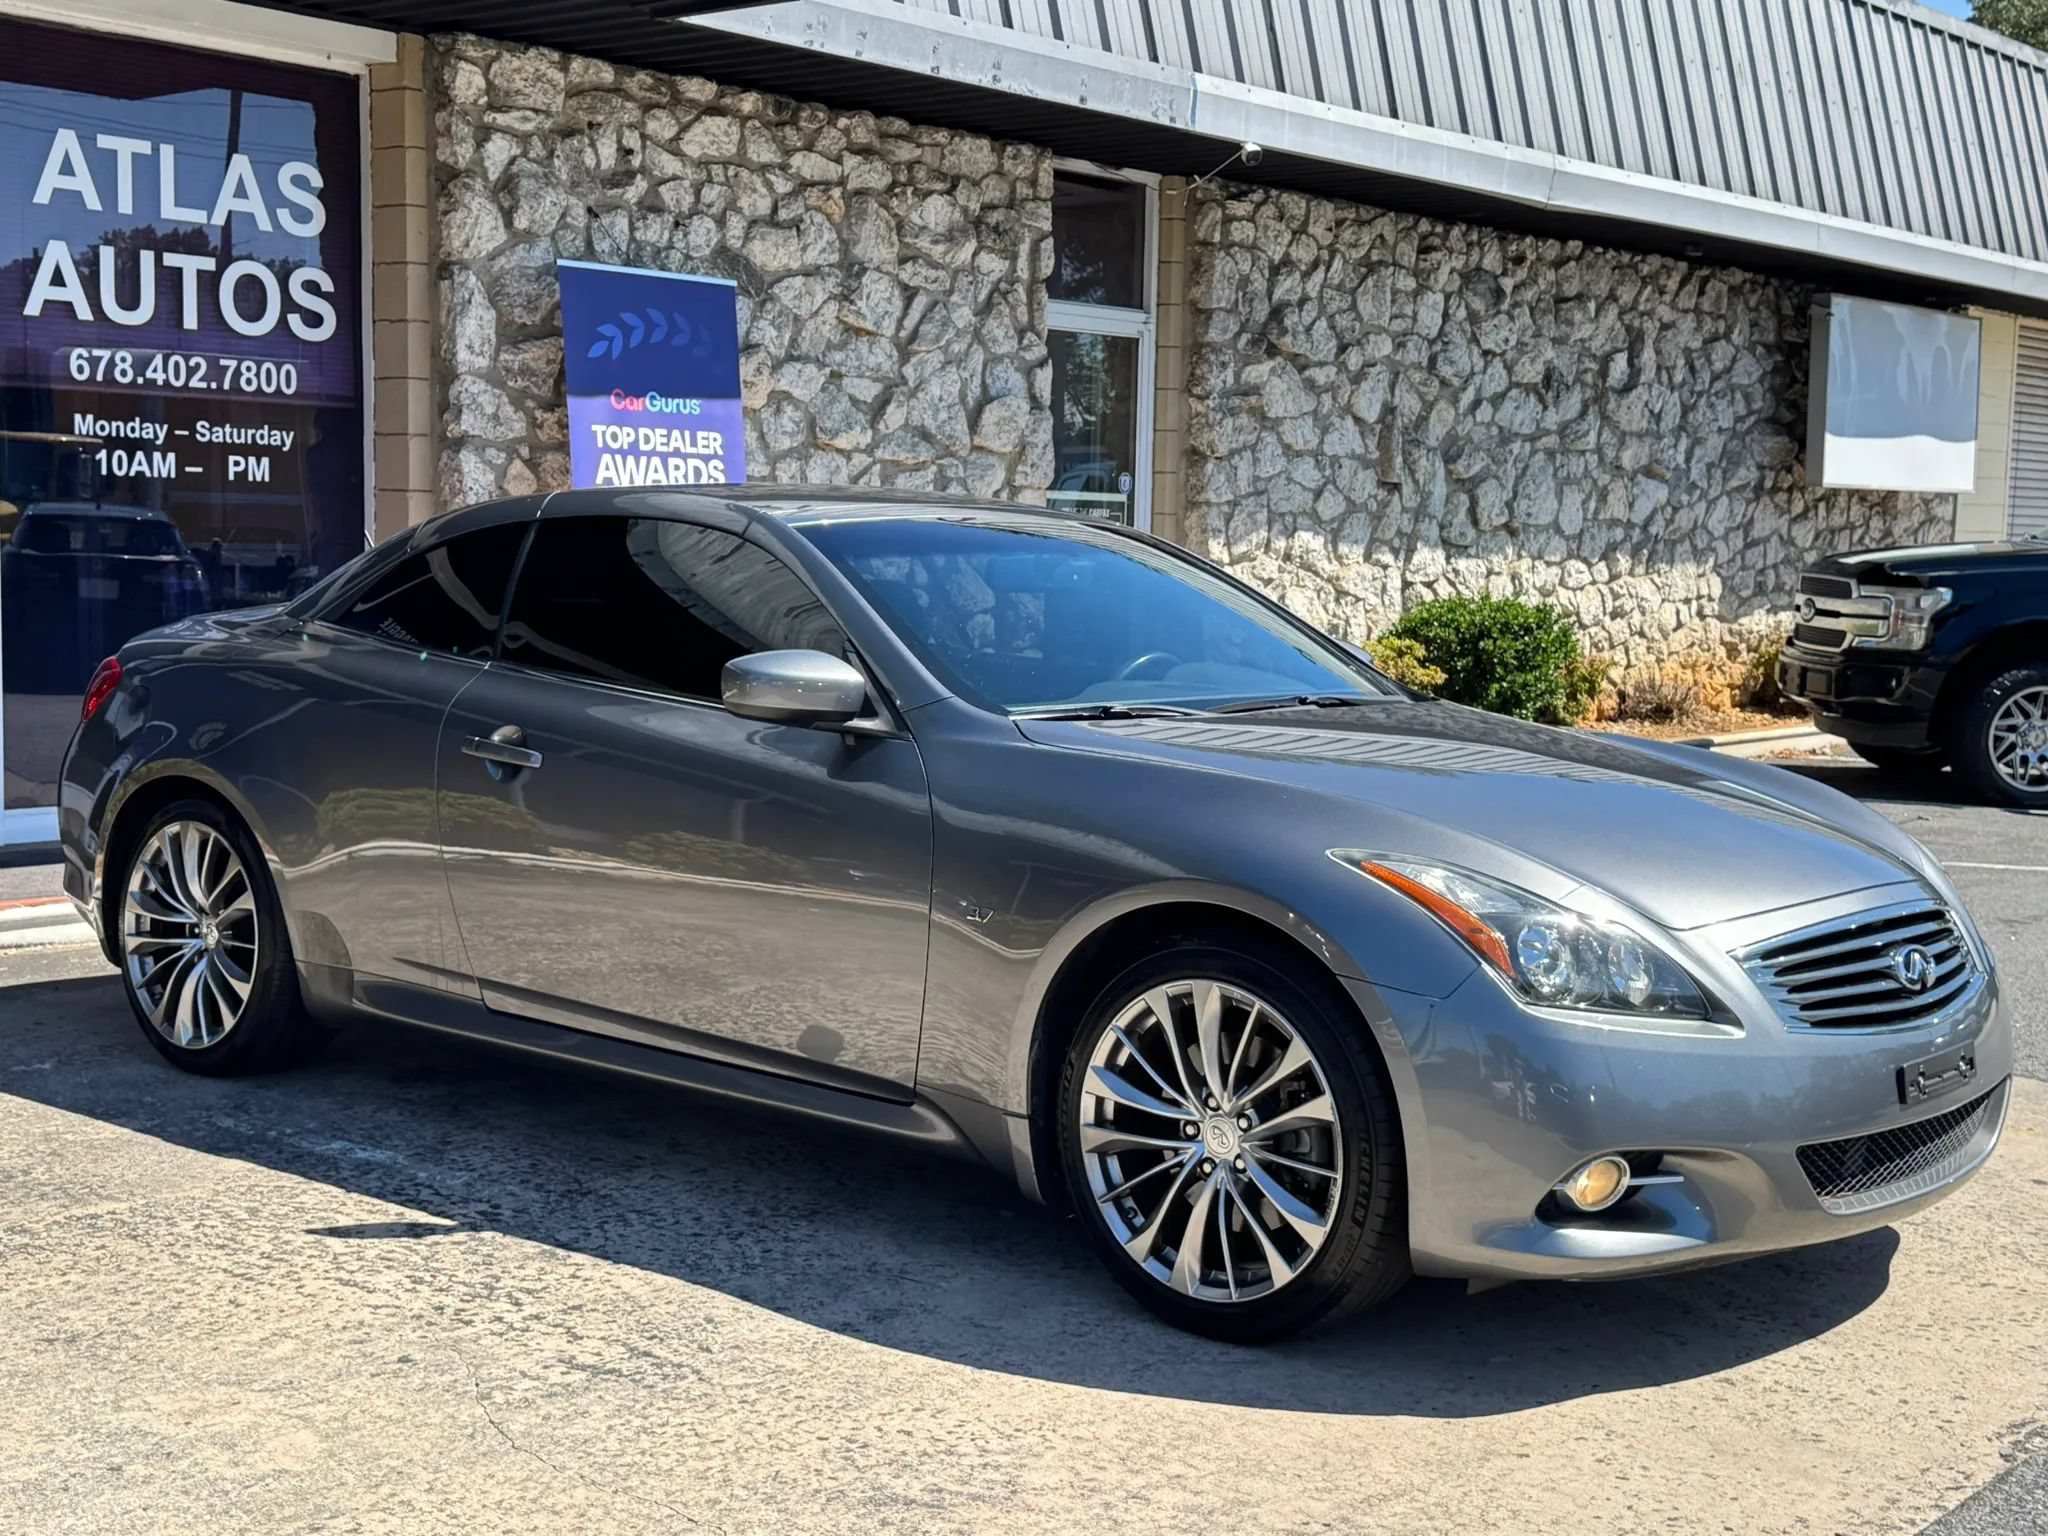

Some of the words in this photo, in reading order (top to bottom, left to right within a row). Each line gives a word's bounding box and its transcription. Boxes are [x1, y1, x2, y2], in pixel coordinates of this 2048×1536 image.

[32, 127, 327, 238] ATLAS
[22, 239, 337, 342] AUTOS
[69, 347, 298, 395] 678.402.7800
[610, 388, 701, 415] CarGurus
[73, 412, 169, 445] Monday
[195, 420, 295, 451] Saturday
[591, 424, 635, 450] TOP
[638, 427, 724, 455] DEALER
[95, 448, 177, 479] 10AM
[227, 455, 270, 483] PM
[595, 453, 726, 487] AWARDS
